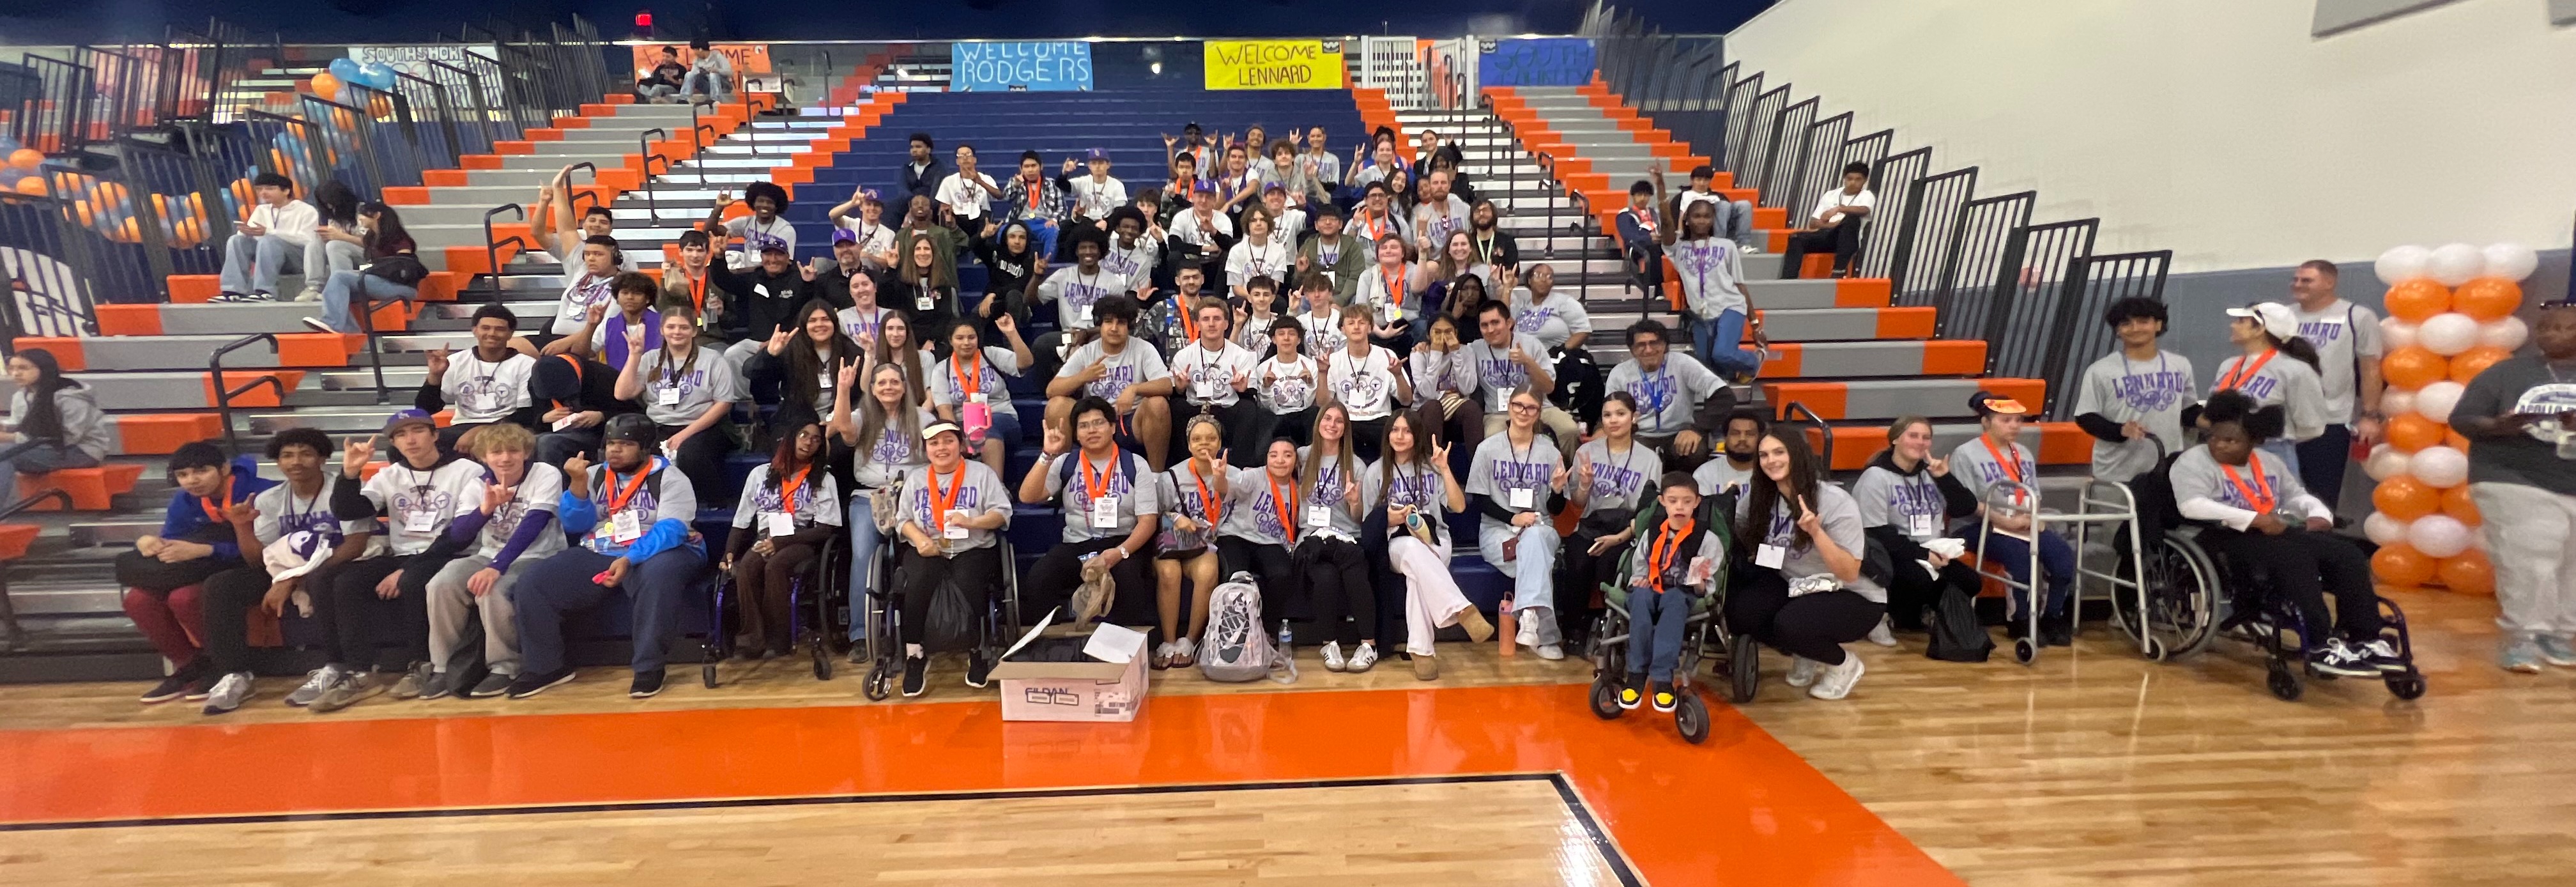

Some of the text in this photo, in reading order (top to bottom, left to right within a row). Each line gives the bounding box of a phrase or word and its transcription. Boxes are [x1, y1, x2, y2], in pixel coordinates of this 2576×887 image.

[958, 42, 1085, 61] WELCOME
[1216, 44, 1316, 66] WELCOME
[962, 58, 1089, 84] RODGERS
[1239, 65, 1312, 86] LENNARD
